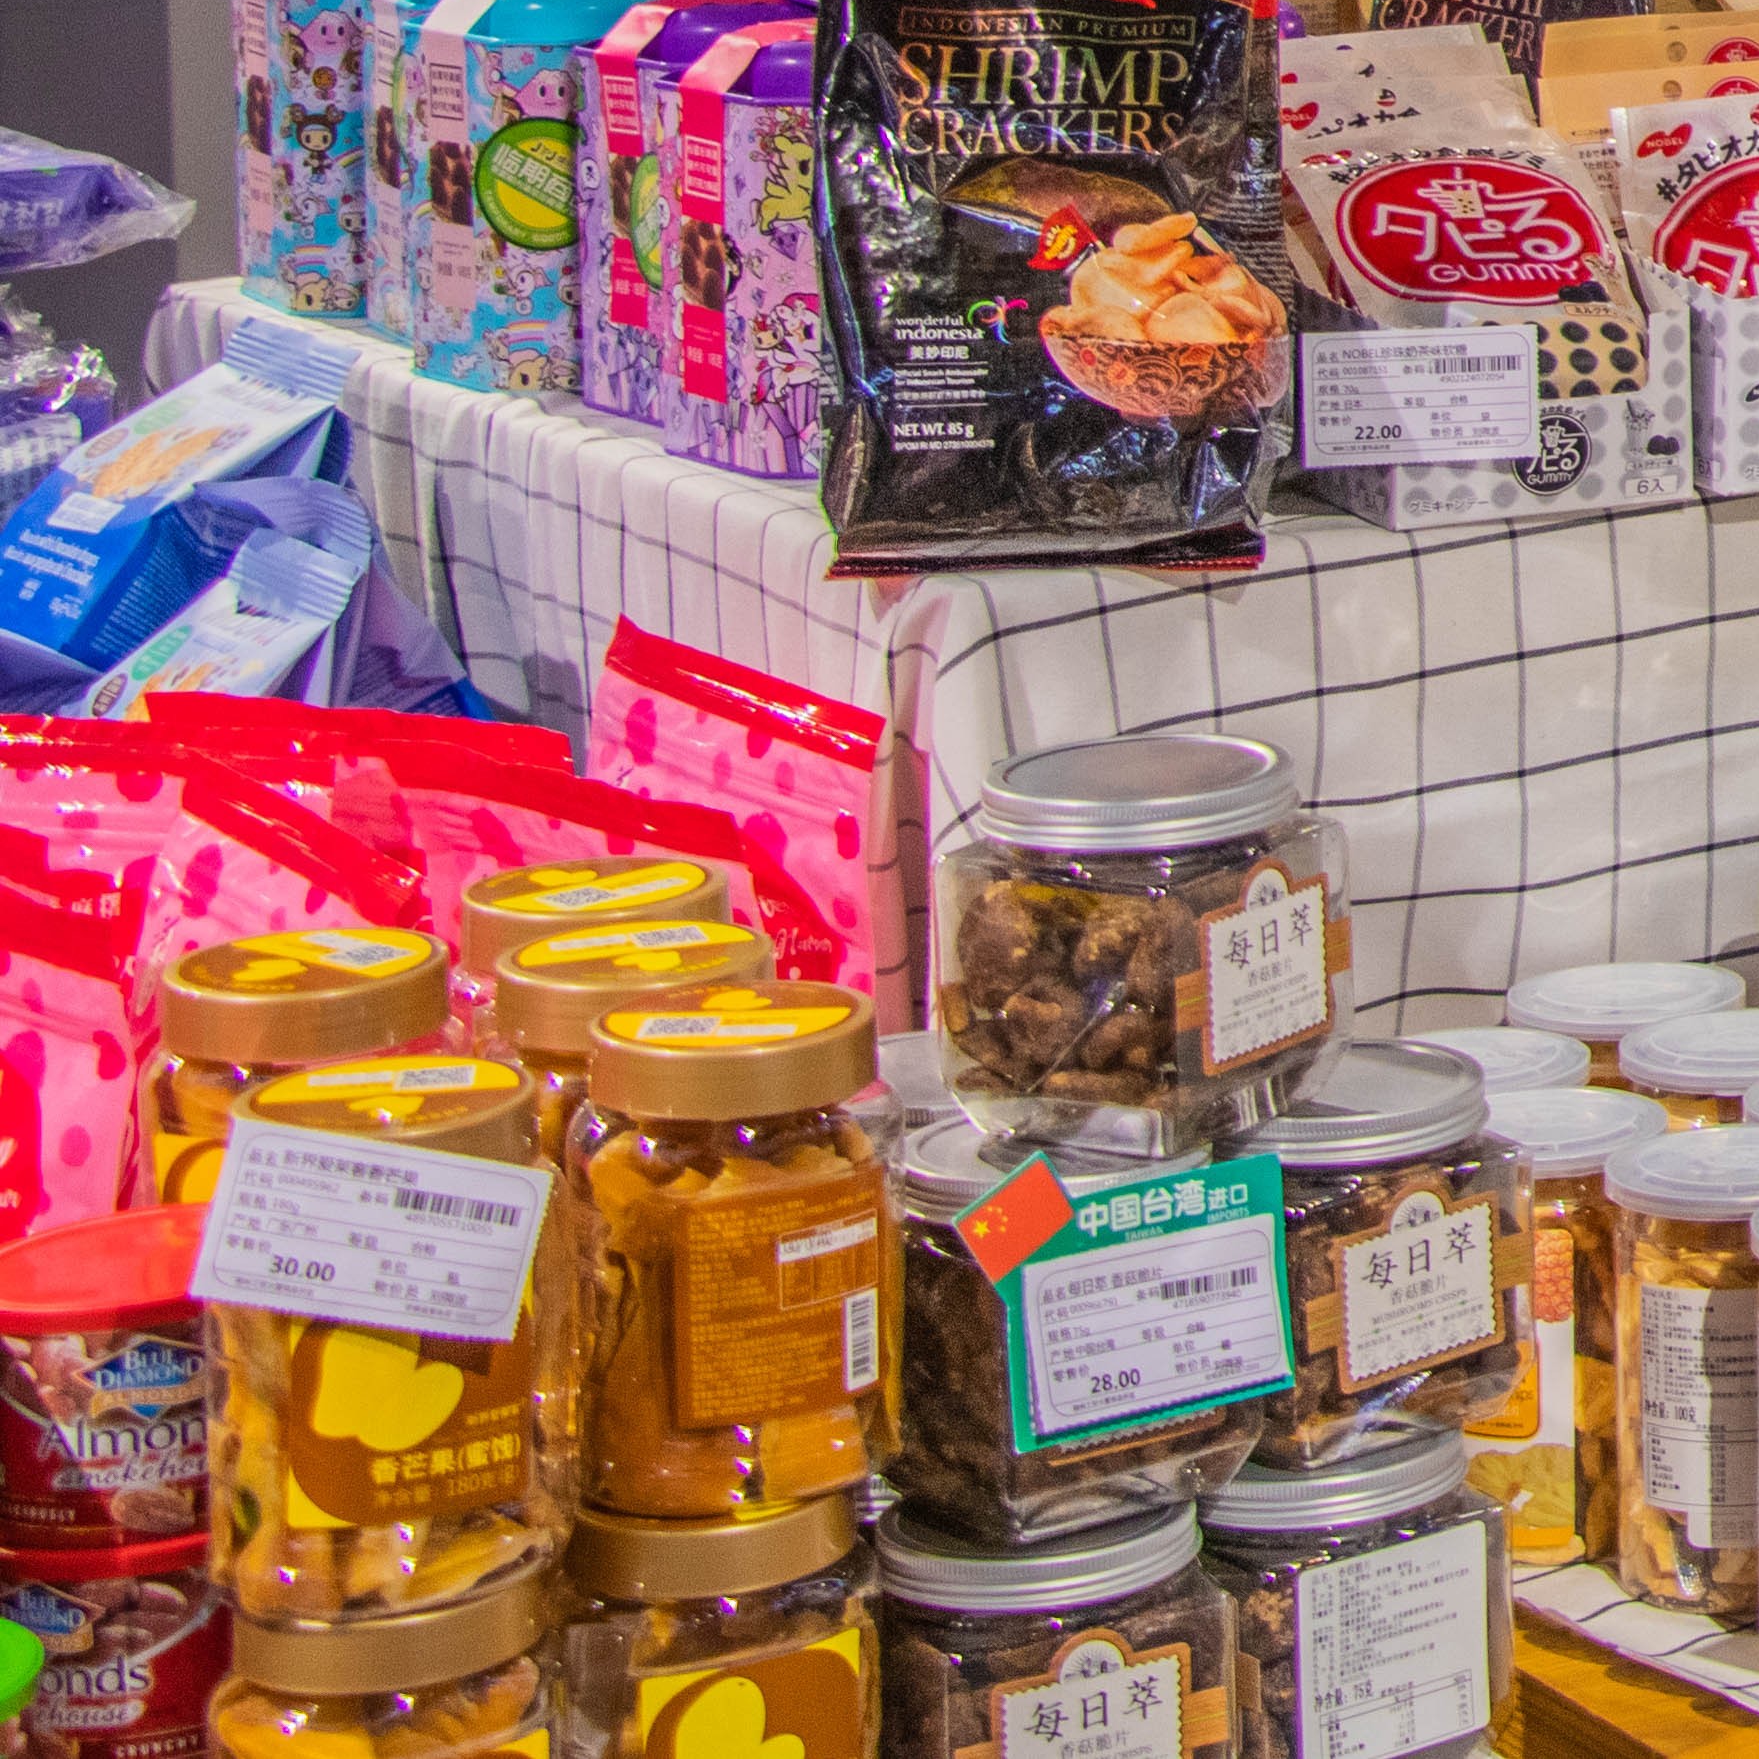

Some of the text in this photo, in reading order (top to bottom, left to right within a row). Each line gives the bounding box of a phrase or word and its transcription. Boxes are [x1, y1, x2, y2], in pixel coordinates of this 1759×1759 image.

[904, 11, 1190, 41] INDONESIAN PREMIUM
[897, 42, 1190, 108] SHRIMP
[897, 104, 1185, 157] CRACKERS
[1371, 174, 1585, 264] タピる
[1427, 257, 1580, 284] GUMMY
[895, 314, 964, 327] wonderful
[895, 327, 985, 340] indonesia
[947, 422, 963, 435] 85
[965, 423, 975, 438] g
[1355, 425, 1401, 440] 22.00
[1637, 476, 1666, 495] 6入
[1223, 903, 1316, 969] 每日萃
[1078, 1179, 1249, 1239] 中国台湾 进口
[270, 1254, 336, 1283] 30.00
[1361, 1221, 1476, 1293] 每日萃
[1091, 1368, 1141, 1393] 28.00
[38, 1413, 208, 1460] Almon
[1031, 1674, 1164, 1741] 每日萃
